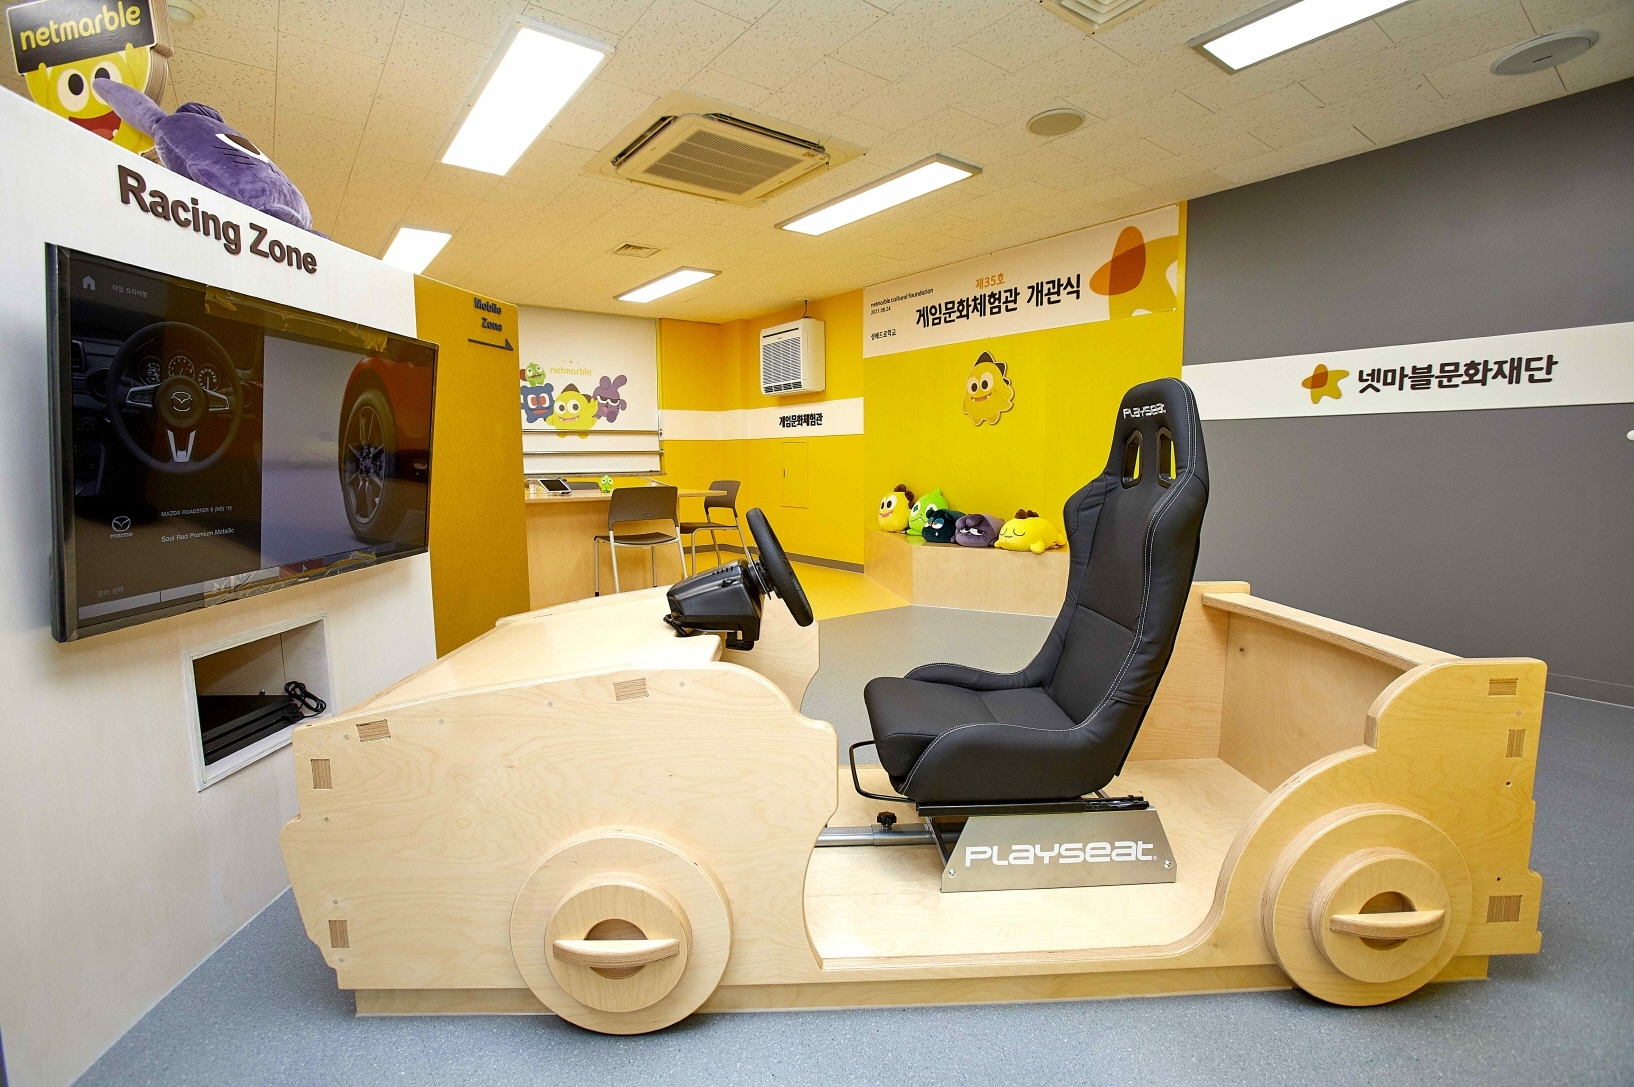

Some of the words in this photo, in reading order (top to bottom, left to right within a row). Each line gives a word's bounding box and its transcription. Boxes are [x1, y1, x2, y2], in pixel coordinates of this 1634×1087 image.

[20, 1, 141, 50] netmarble
[117, 164, 242, 255] Racing
[249, 222, 318, 274] Zone
[975, 272, 1005, 290] 제35호
[890, 294, 908, 303] cultural
[908, 288, 934, 299] foundation
[915, 287, 1021, 329] 게임문화체험관
[1026, 273, 1081, 307] 개관식
[474, 297, 502, 315] Mobile
[481, 317, 503, 332] Zone
[550, 366, 593, 376] netmarble
[1357, 354, 1559, 394] 넷마블문화재단
[778, 412, 824, 429] 게임문화체험관
[181, 507, 209, 516] ROADSTER
[161, 535, 175, 543] Soul
[176, 533, 189, 541] Red
[189, 530, 214, 539] Premium
[214, 527, 235, 536] Metallic
